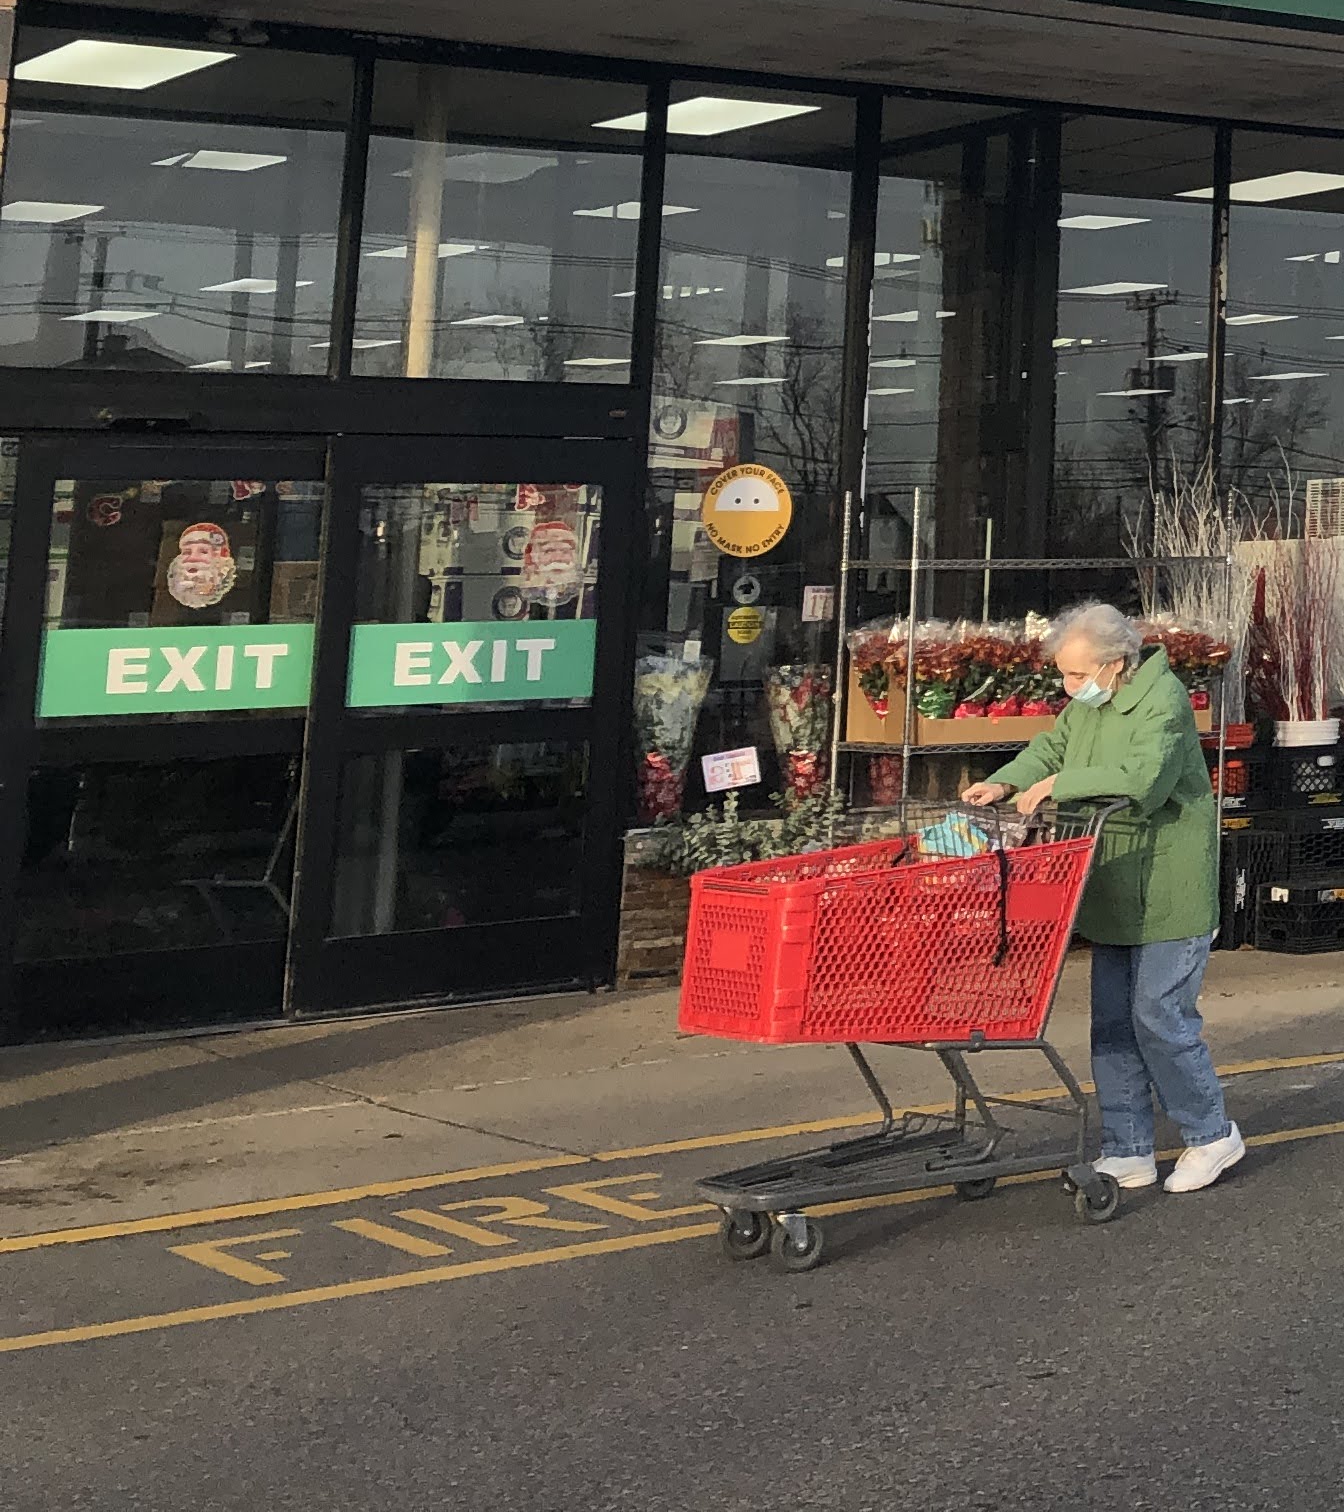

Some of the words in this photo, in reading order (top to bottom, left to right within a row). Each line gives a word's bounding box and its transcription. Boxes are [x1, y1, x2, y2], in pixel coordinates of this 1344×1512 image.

[710, 469, 739, 496] COVER
[740, 466, 766, 478] YOUR
[766, 473, 785, 495] FACE
[706, 522, 719, 538] NO
[716, 536, 743, 554] MASK
[745, 544, 760, 554] NO
[761, 523, 785, 548] ENTRY
[105, 643, 290, 695] EXIT
[393, 638, 556, 687] EXIT
[167, 1171, 719, 1287] FIRE
